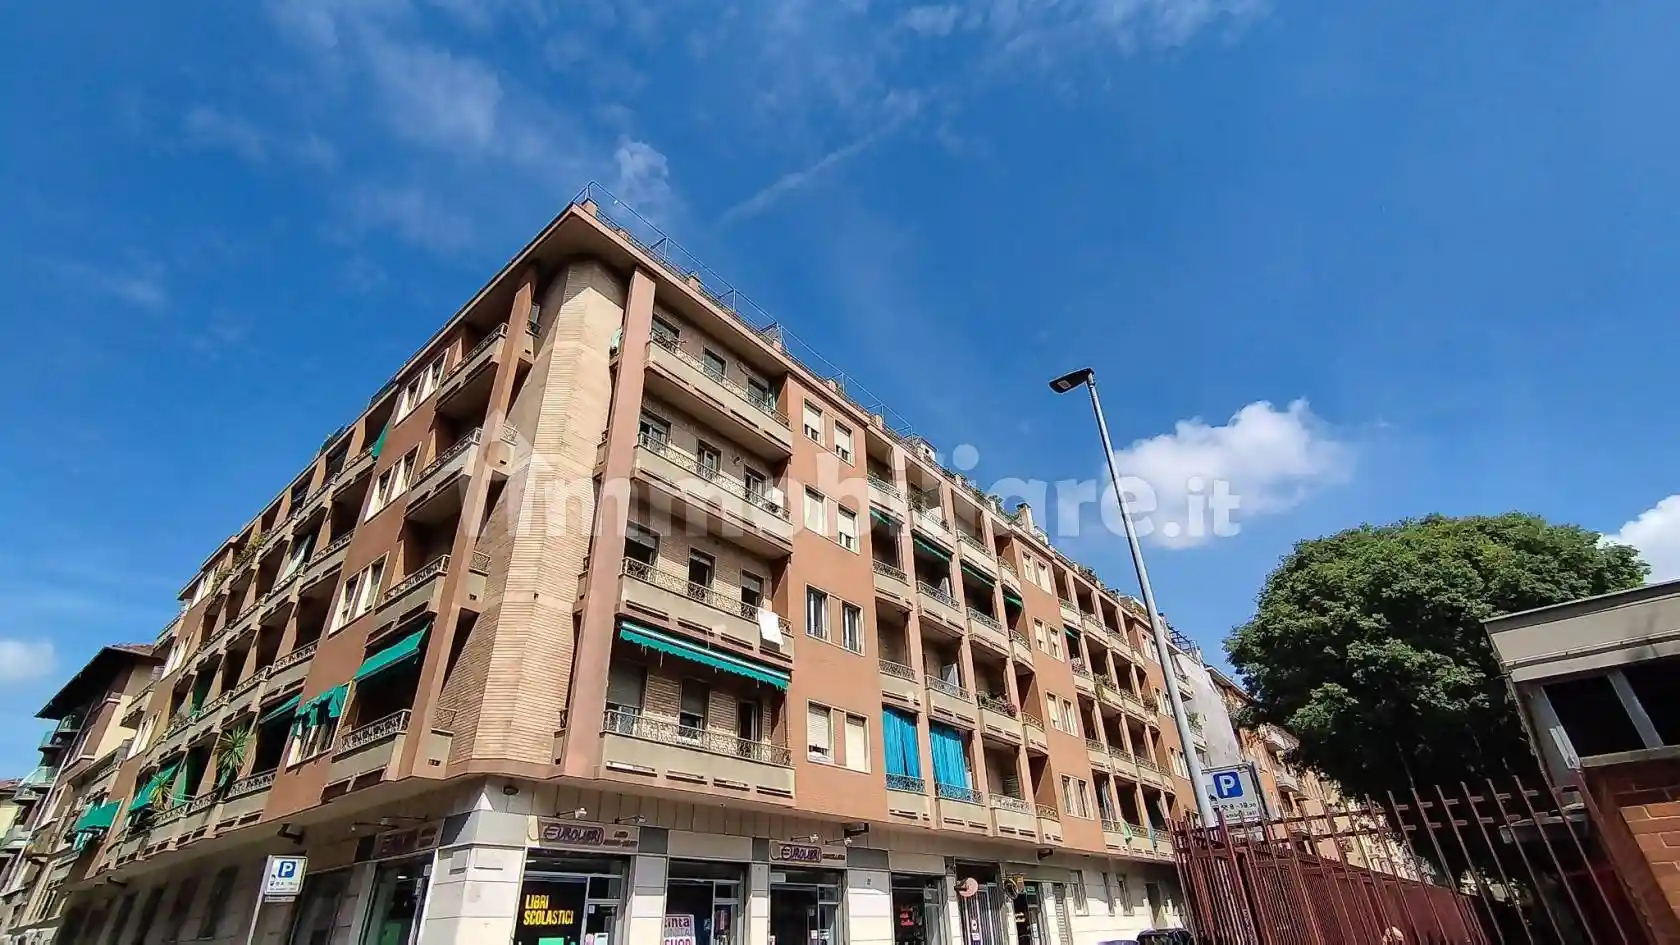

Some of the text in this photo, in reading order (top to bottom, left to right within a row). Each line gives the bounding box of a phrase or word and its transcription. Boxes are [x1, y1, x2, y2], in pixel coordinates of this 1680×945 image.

[1219, 775, 1236, 796] P
[281, 862, 294, 877] P
[525, 894, 549, 909] LIBRI
[523, 910, 574, 925] SCOLASTICI
